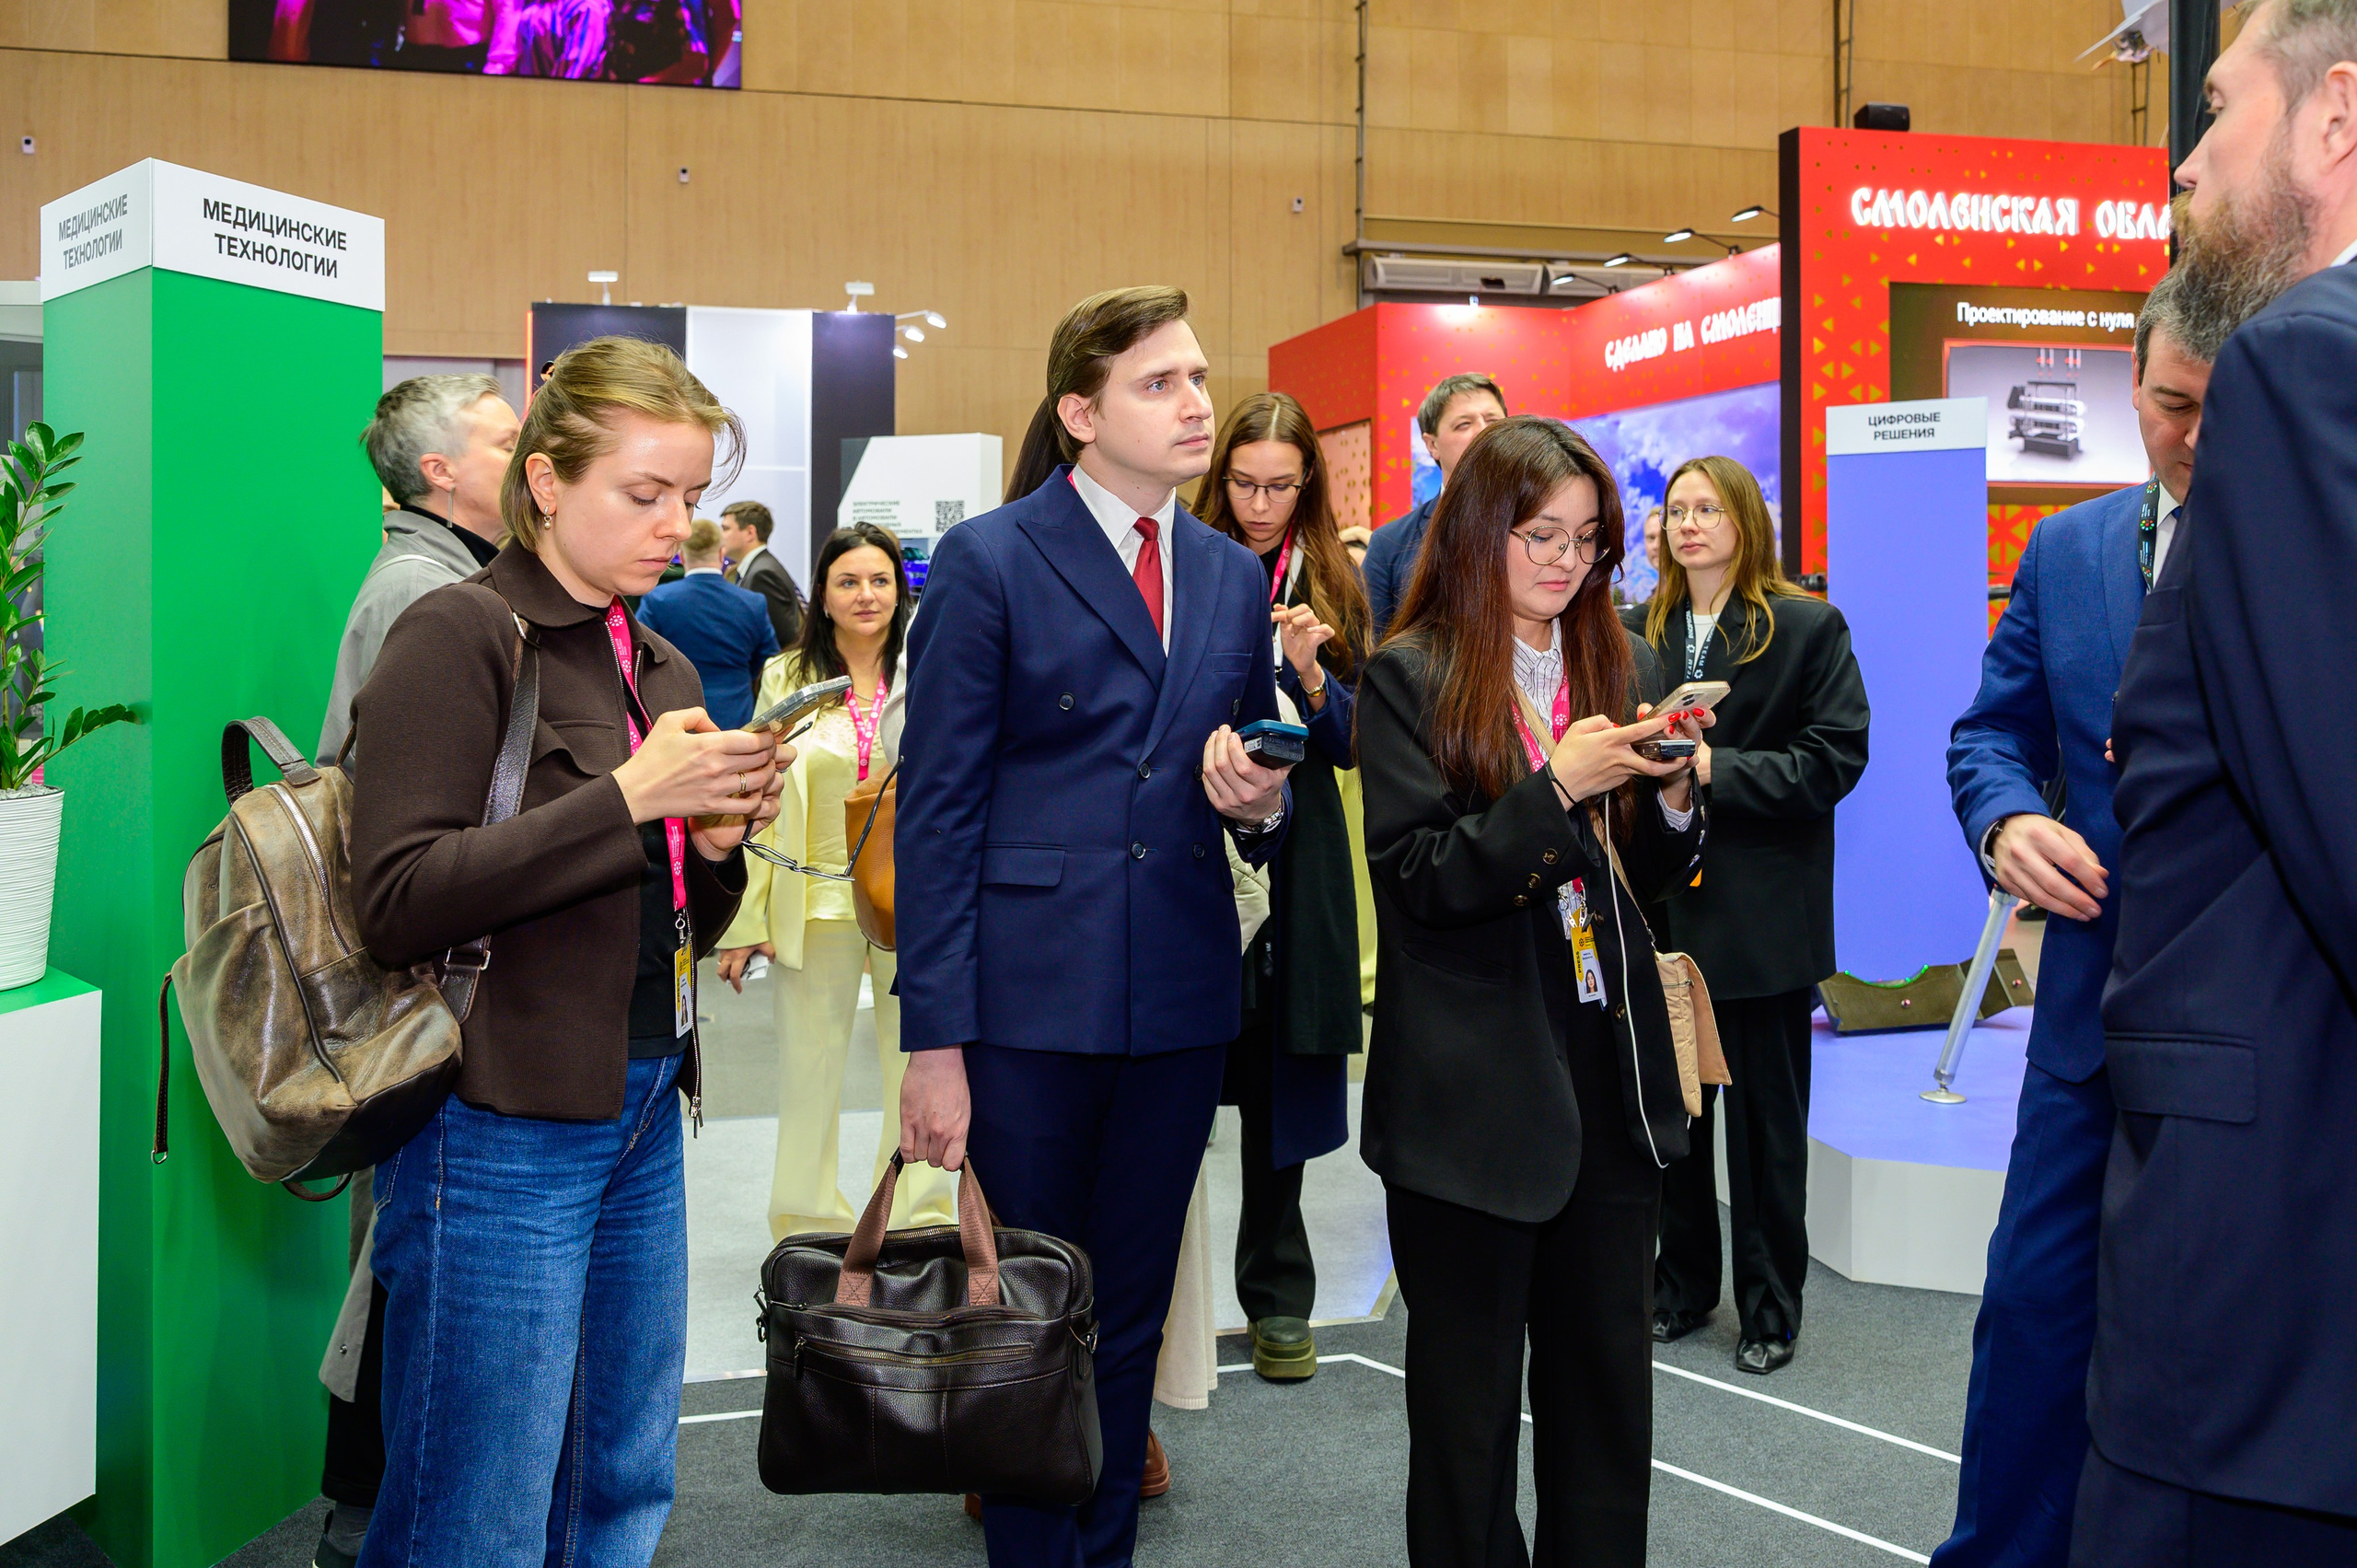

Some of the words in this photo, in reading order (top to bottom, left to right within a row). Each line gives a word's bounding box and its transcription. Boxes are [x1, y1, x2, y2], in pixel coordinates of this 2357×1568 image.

[58, 193, 128, 241] МЕДИЦИНСКИЕ
[203, 198, 347, 251] МЕДИЦИНСКИЕ
[1851, 187, 2079, 236] СМОЛЕНСКАЯ
[63, 228, 122, 270] ТЕХНОЛОГИИ
[214, 233, 338, 279] ТЕХНОЛОГИИ
[1673, 319, 1694, 352] НА
[1957, 302, 2085, 329] Проектирование
[2086, 311, 2097, 328] с
[2099, 312, 2135, 332] нуля
[1868, 412, 1941, 426] ЦИФРОВЫЕ
[1874, 428, 1934, 440] РЕШЕНИЯ
[1699, 645, 1709, 667] TEAM
